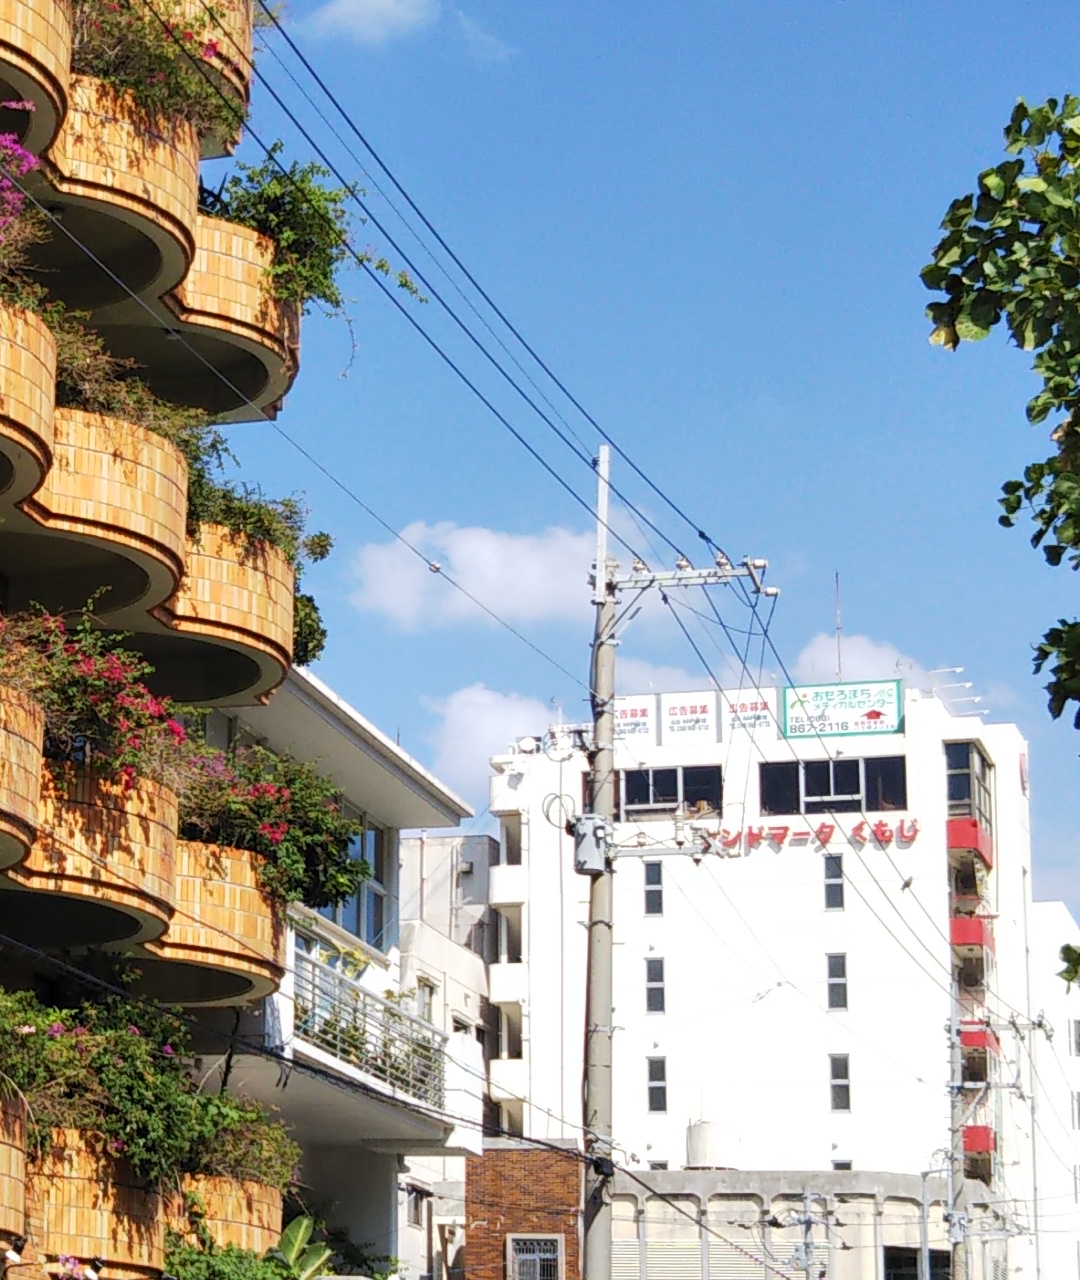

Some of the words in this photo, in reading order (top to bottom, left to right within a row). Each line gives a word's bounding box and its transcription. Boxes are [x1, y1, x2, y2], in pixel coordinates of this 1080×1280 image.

[614, 708, 649, 719] 告募集
[668, 705, 709, 716] 広告募集
[789, 721, 849, 734] 867-2116
[703, 822, 836, 849] ンドマーク
[852, 818, 920, 843] くもじ
